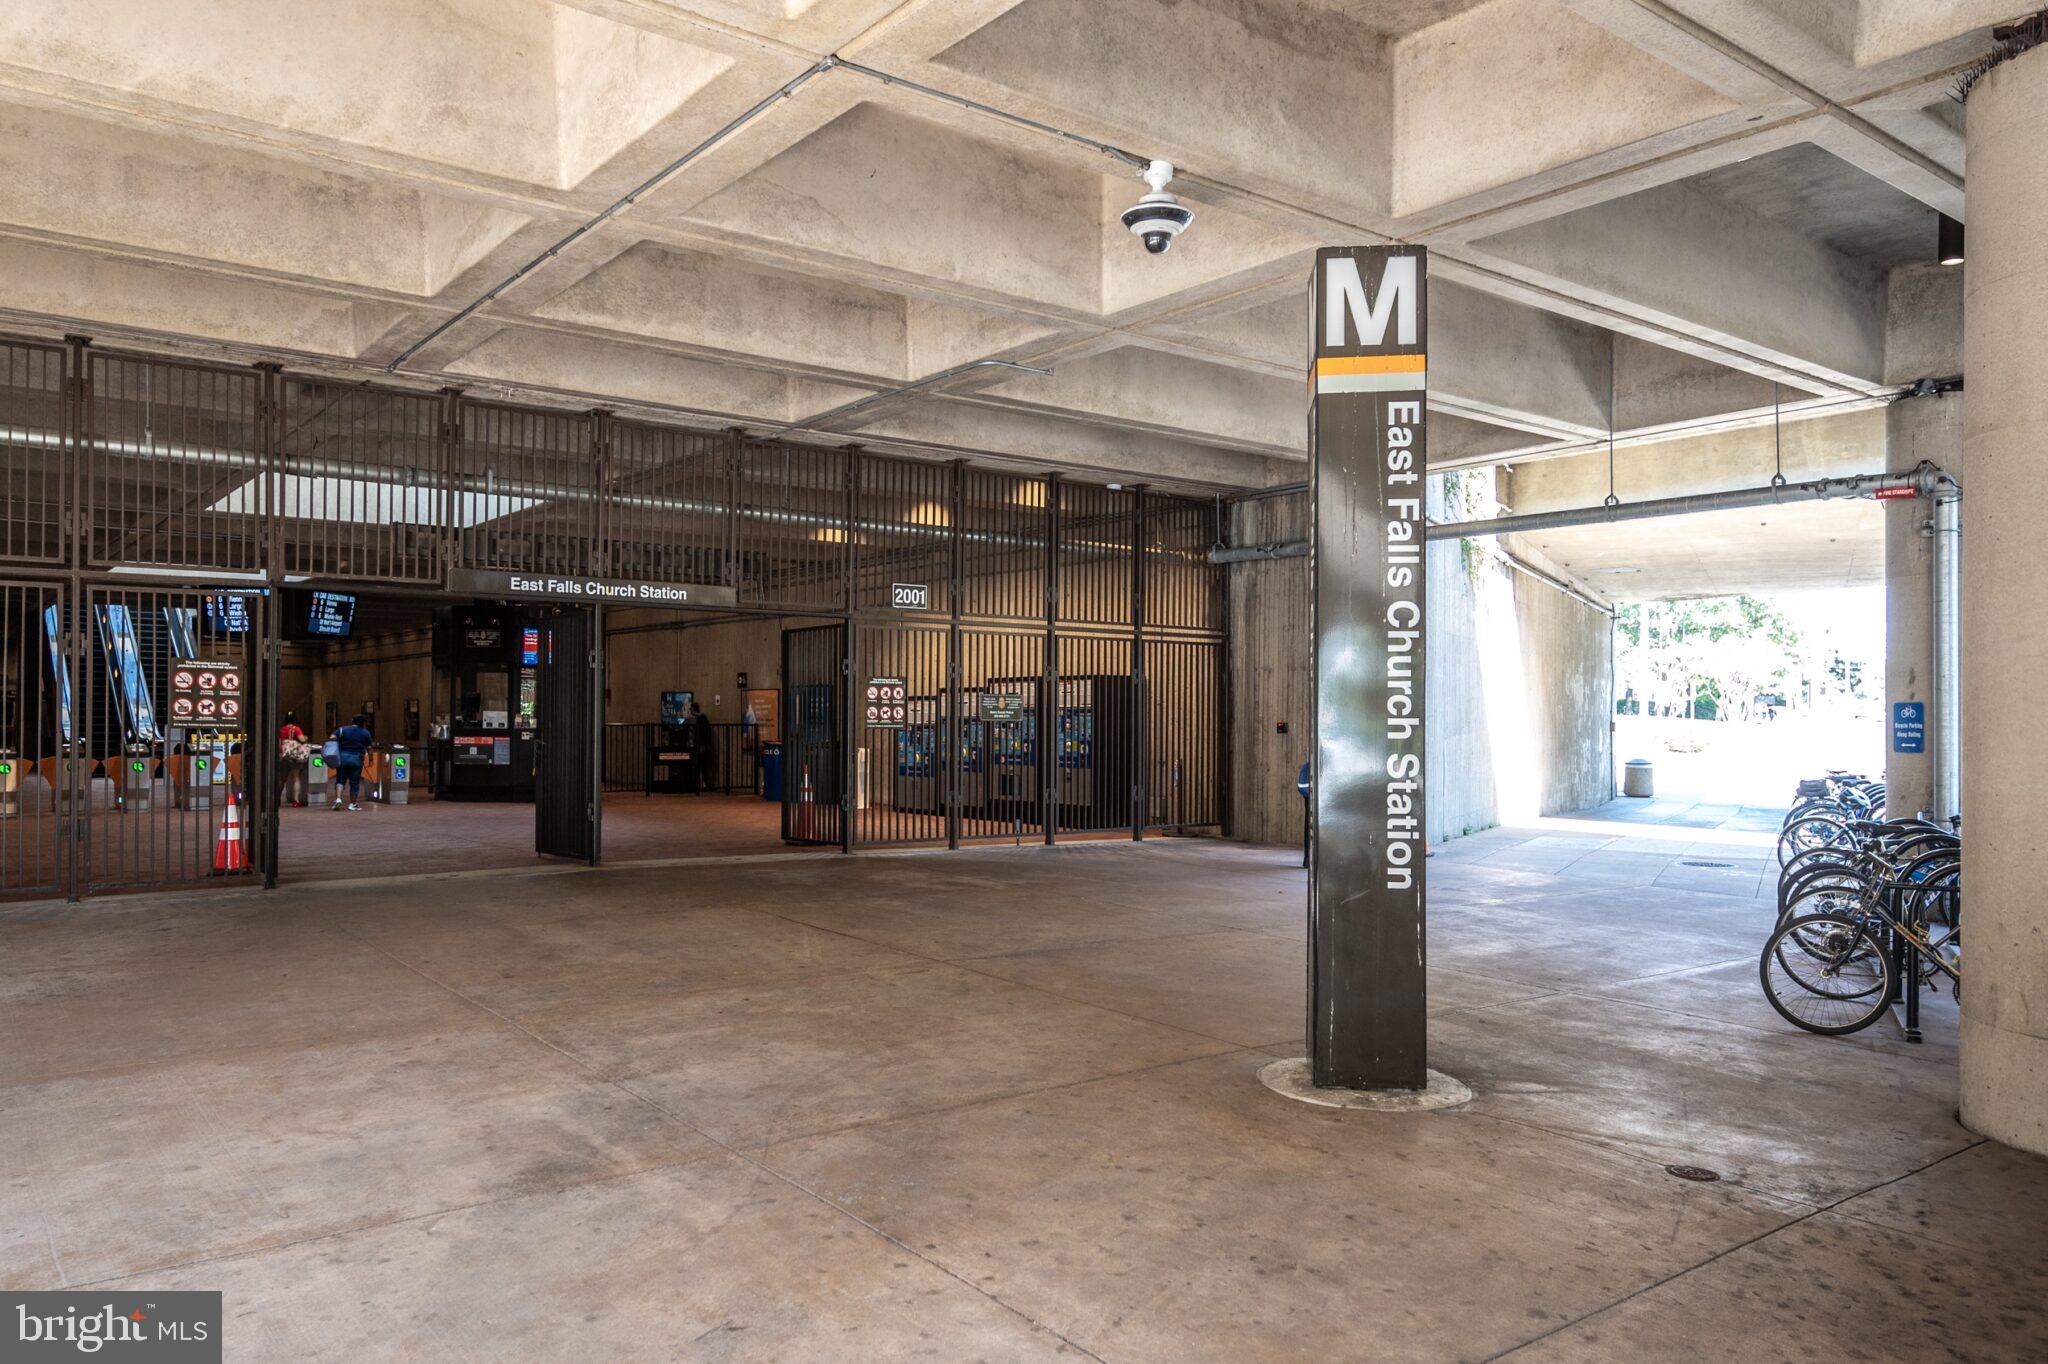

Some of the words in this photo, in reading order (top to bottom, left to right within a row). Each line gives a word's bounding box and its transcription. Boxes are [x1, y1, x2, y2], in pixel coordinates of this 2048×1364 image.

[1326, 256, 1418, 347] M
[1387, 401, 1420, 485] East
[1387, 498, 1420, 588] Falls
[510, 577, 544, 592] East
[547, 579, 582, 594] Falls
[585, 582, 637, 598] Church
[640, 585, 688, 601] Station
[894, 588, 925, 605] 2001
[1387, 600, 1421, 740] Church
[1908, 722, 1923, 730] Parking
[1386, 753, 1420, 889] Station
